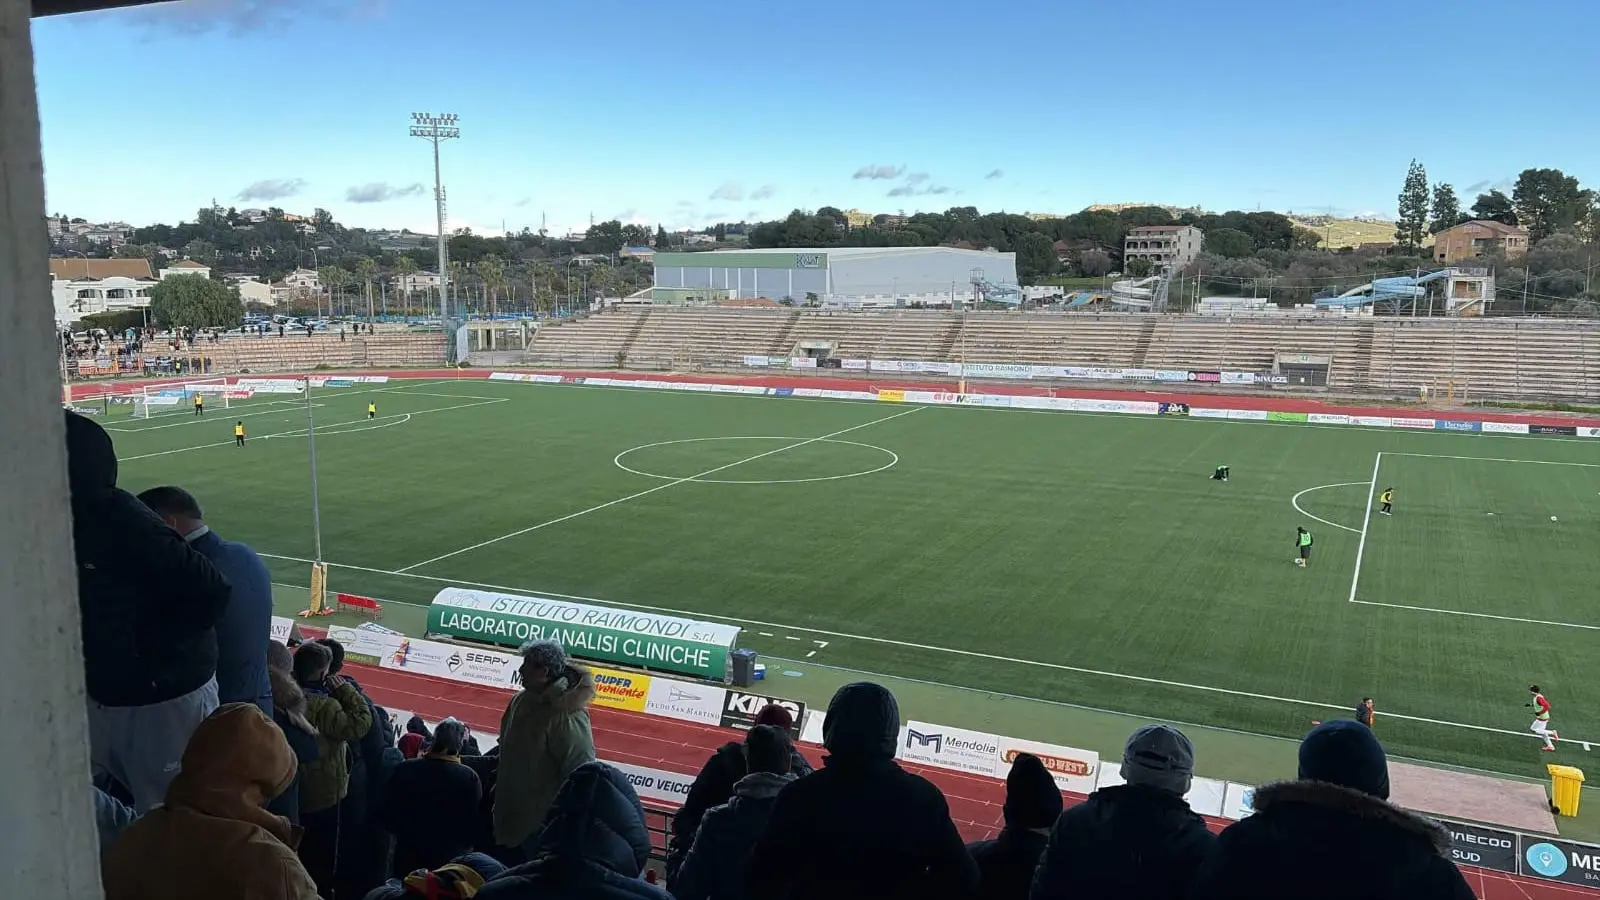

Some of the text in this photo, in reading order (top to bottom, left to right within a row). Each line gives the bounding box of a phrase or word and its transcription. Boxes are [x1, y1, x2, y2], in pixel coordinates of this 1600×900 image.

[489, 597, 716, 643] ISTITUTO RAIMONDI s.r.l.
[440, 611, 711, 668] LABORATORI ANALISI CLINICHE
[594, 674, 632, 688] SUPER
[671, 704, 685, 713] SAN
[686, 707, 720, 719] MARTINO
[945, 736, 997, 754] Mendolia
[1056, 760, 1085, 773] WEST
[626, 773, 691, 795] GGIO VEICO
[1452, 849, 1481, 862] SUD
